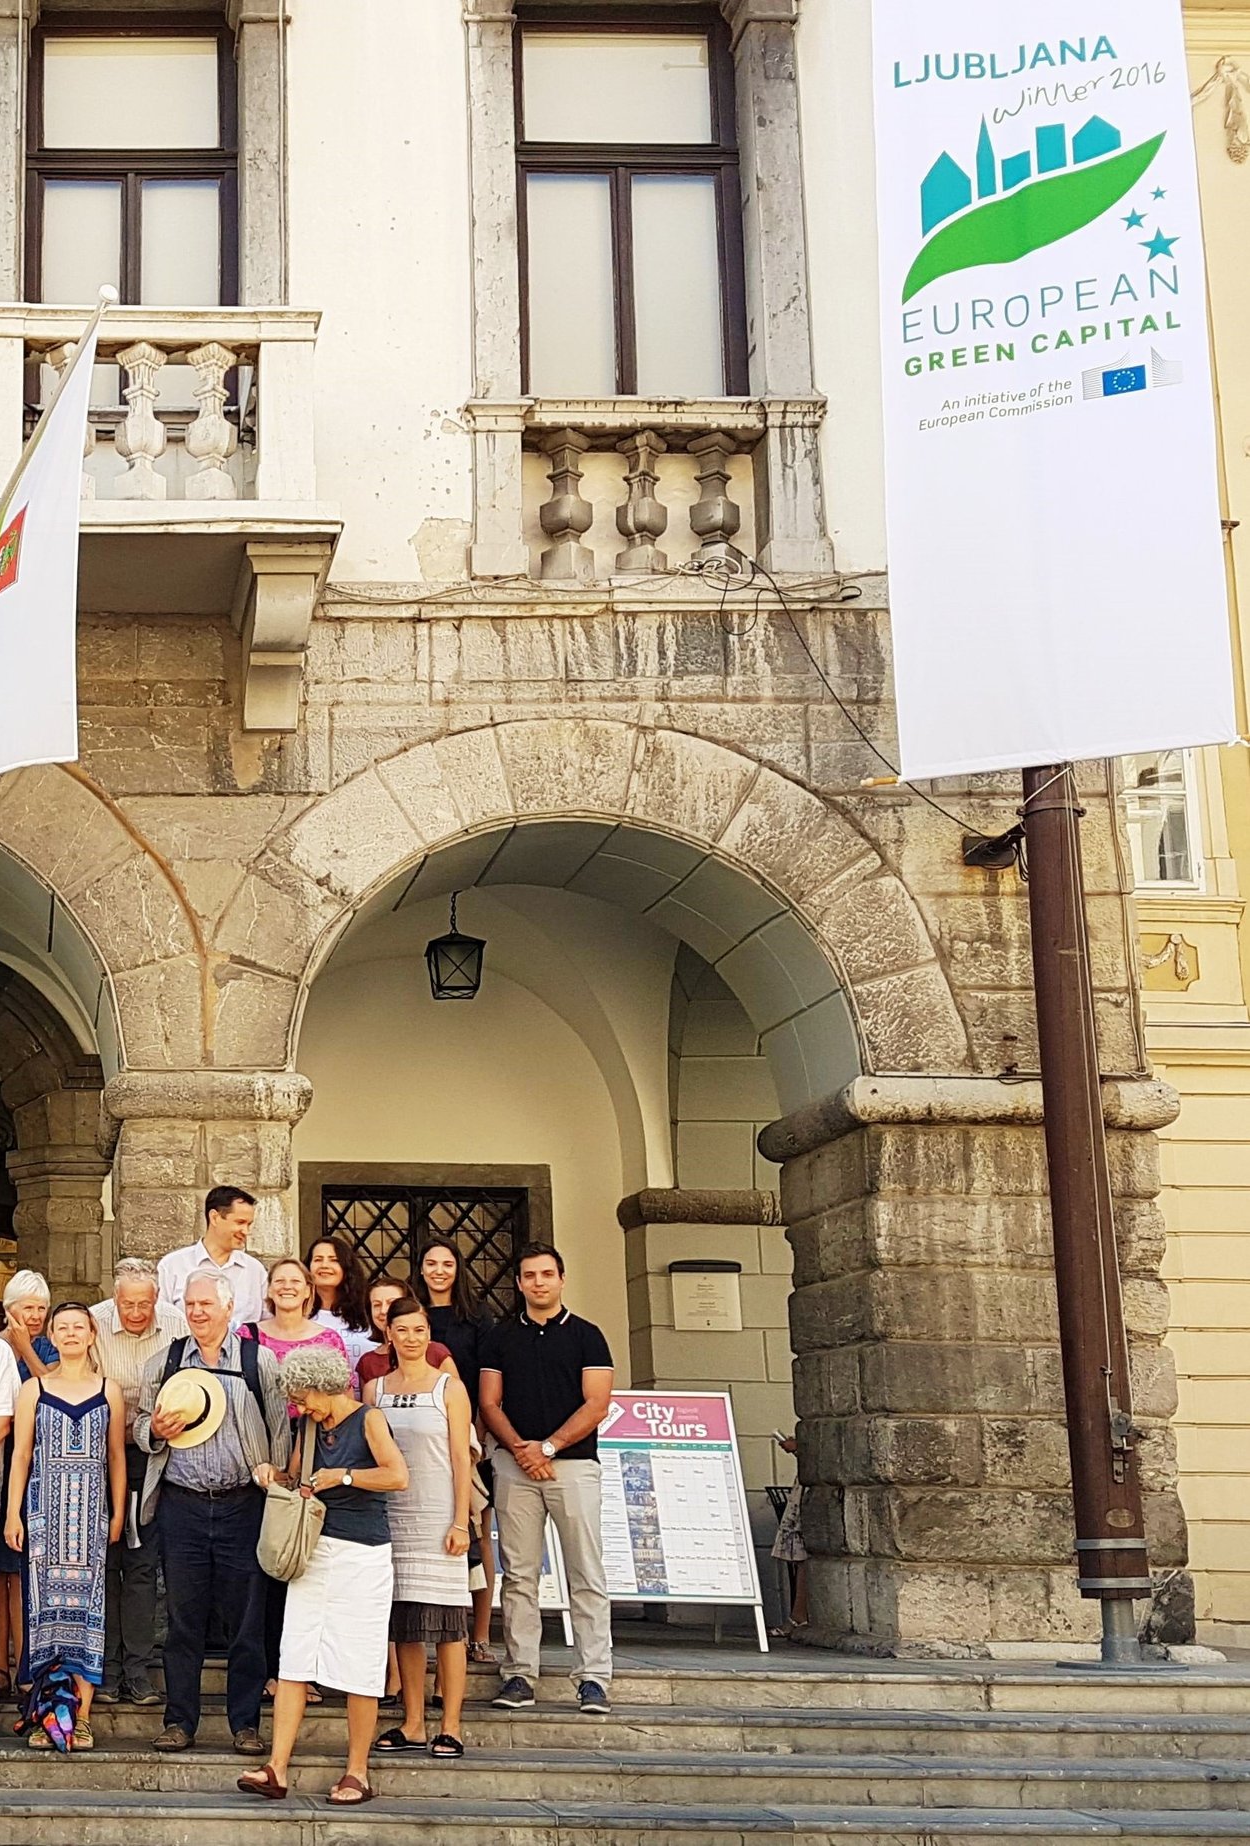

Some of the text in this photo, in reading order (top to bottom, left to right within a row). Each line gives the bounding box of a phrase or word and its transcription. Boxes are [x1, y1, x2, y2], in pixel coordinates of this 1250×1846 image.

[893, 35, 1118, 88] LJUBLJANA
[1110, 61, 1166, 90] 2016
[902, 265, 1179, 344] EUROPEAN
[904, 311, 1181, 377] GREEN CAPITAL
[918, 394, 1074, 431] European Commission
[940, 379, 1073, 412] An initiative of the
[632, 1402, 674, 1423] City
[645, 1419, 708, 1437] Tours
